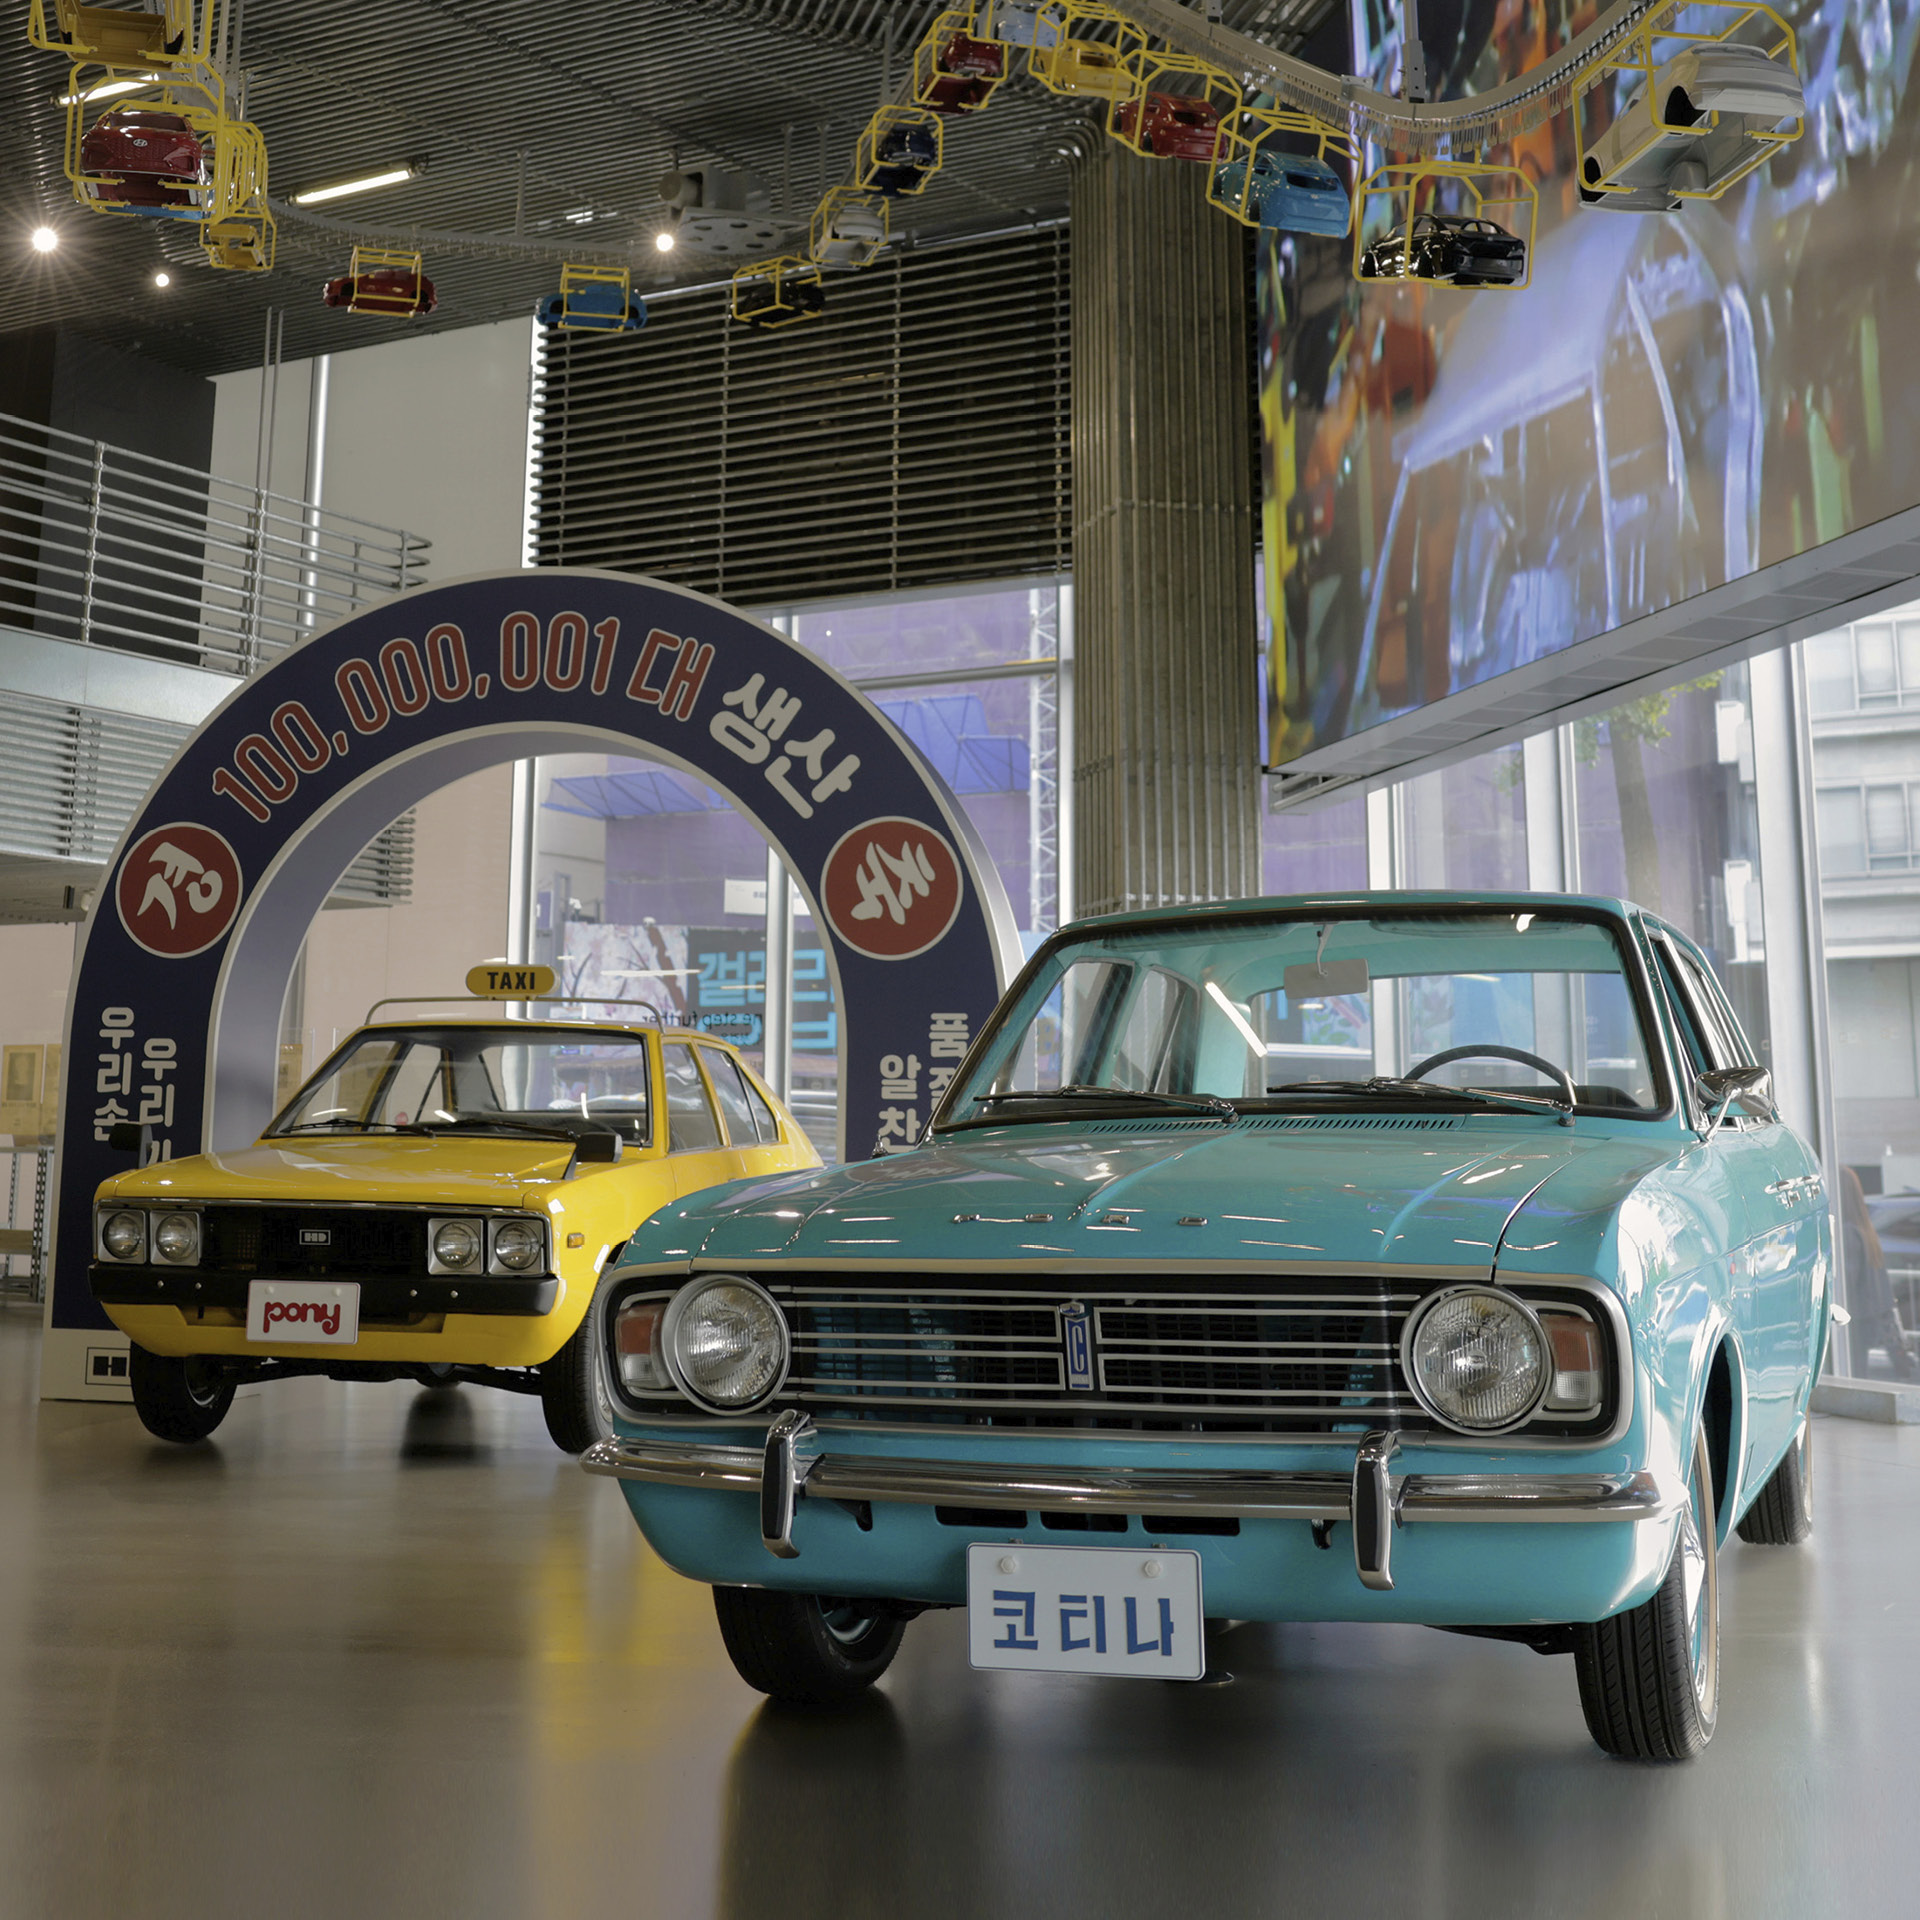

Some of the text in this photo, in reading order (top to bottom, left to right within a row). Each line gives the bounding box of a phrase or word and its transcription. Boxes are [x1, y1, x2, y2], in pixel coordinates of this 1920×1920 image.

[212, 611, 861, 823] 100,000,001 대 생산
[137, 841, 223, 931] 경
[850, 840, 936, 926] 축
[487, 972, 535, 990] TAXI
[878, 1054, 922, 1154] 알찬
[263, 1301, 341, 1335] pony
[93, 1356, 127, 1377] H
[993, 1589, 1175, 1657] 코티나
